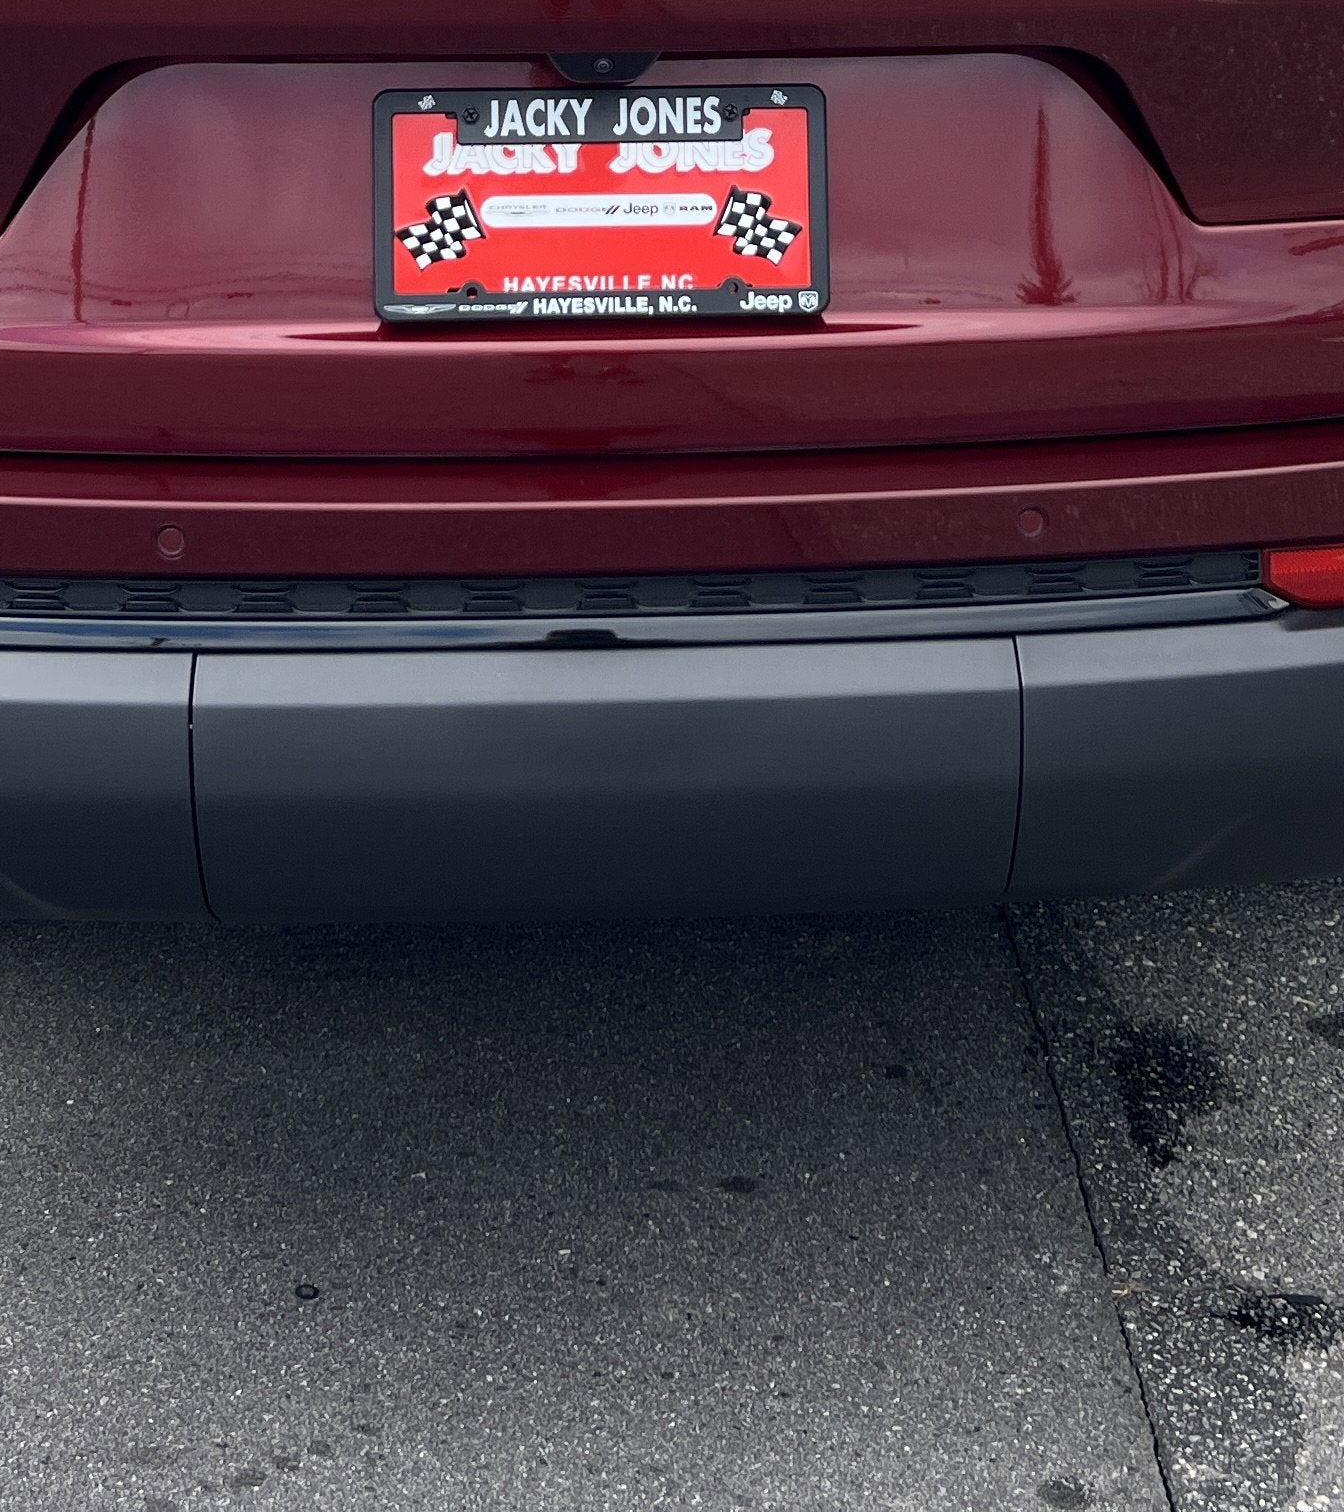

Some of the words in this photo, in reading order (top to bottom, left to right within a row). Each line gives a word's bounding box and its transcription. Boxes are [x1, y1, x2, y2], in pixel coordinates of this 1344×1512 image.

[484, 97, 593, 138] JACKY
[612, 95, 722, 136] JONES
[422, 131, 582, 175] JACKY
[609, 127, 775, 174] JONES
[623, 202, 659, 216] Jeep
[533, 297, 654, 315] HAYESVILLE,
[659, 295, 698, 314] N.C.
[740, 291, 793, 312] Jeep
